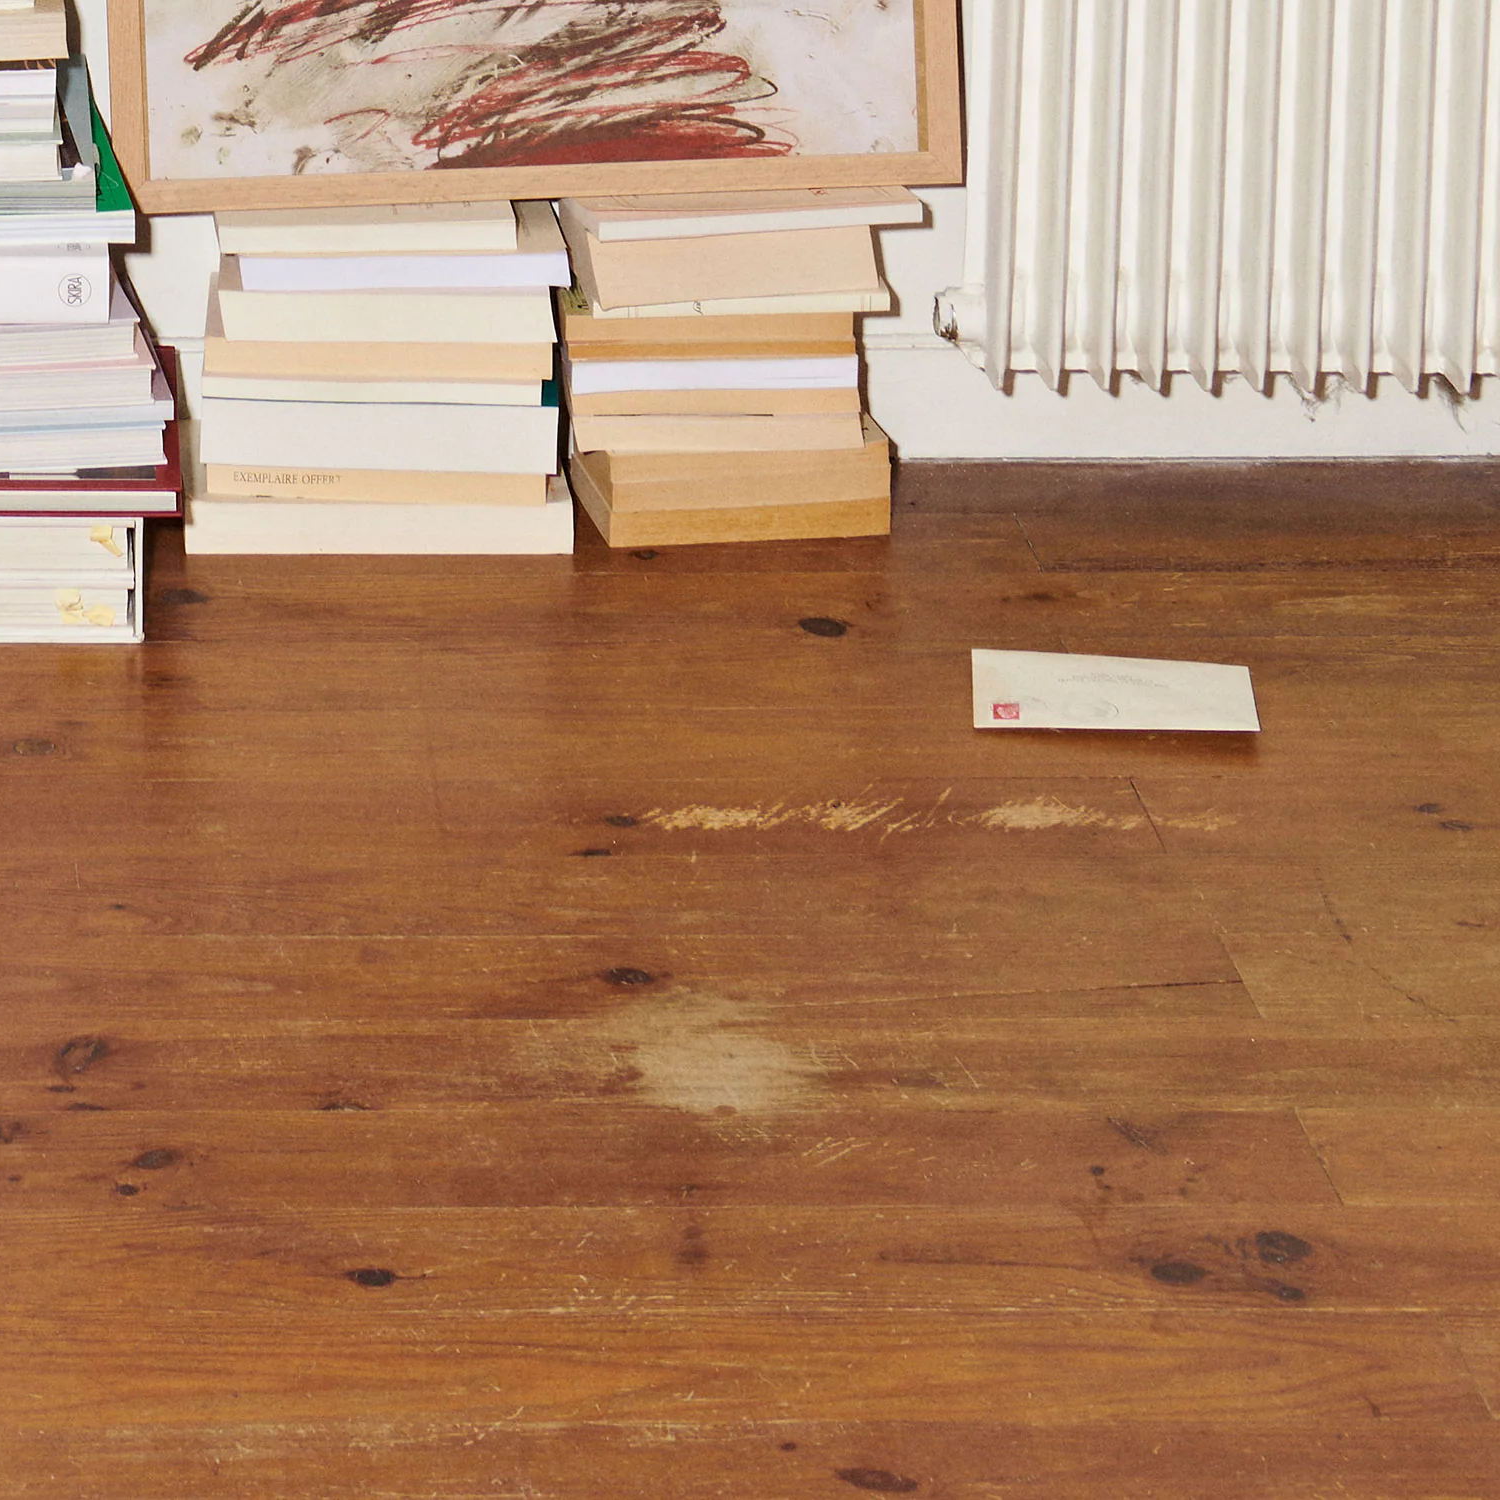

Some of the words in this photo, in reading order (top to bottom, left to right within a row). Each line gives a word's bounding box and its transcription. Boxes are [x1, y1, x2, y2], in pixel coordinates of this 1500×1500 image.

[67, 276, 82, 305] SKIRA
[233, 471, 298, 485] EXEMPLAIRE
[301, 474, 342, 485] OFFERT
